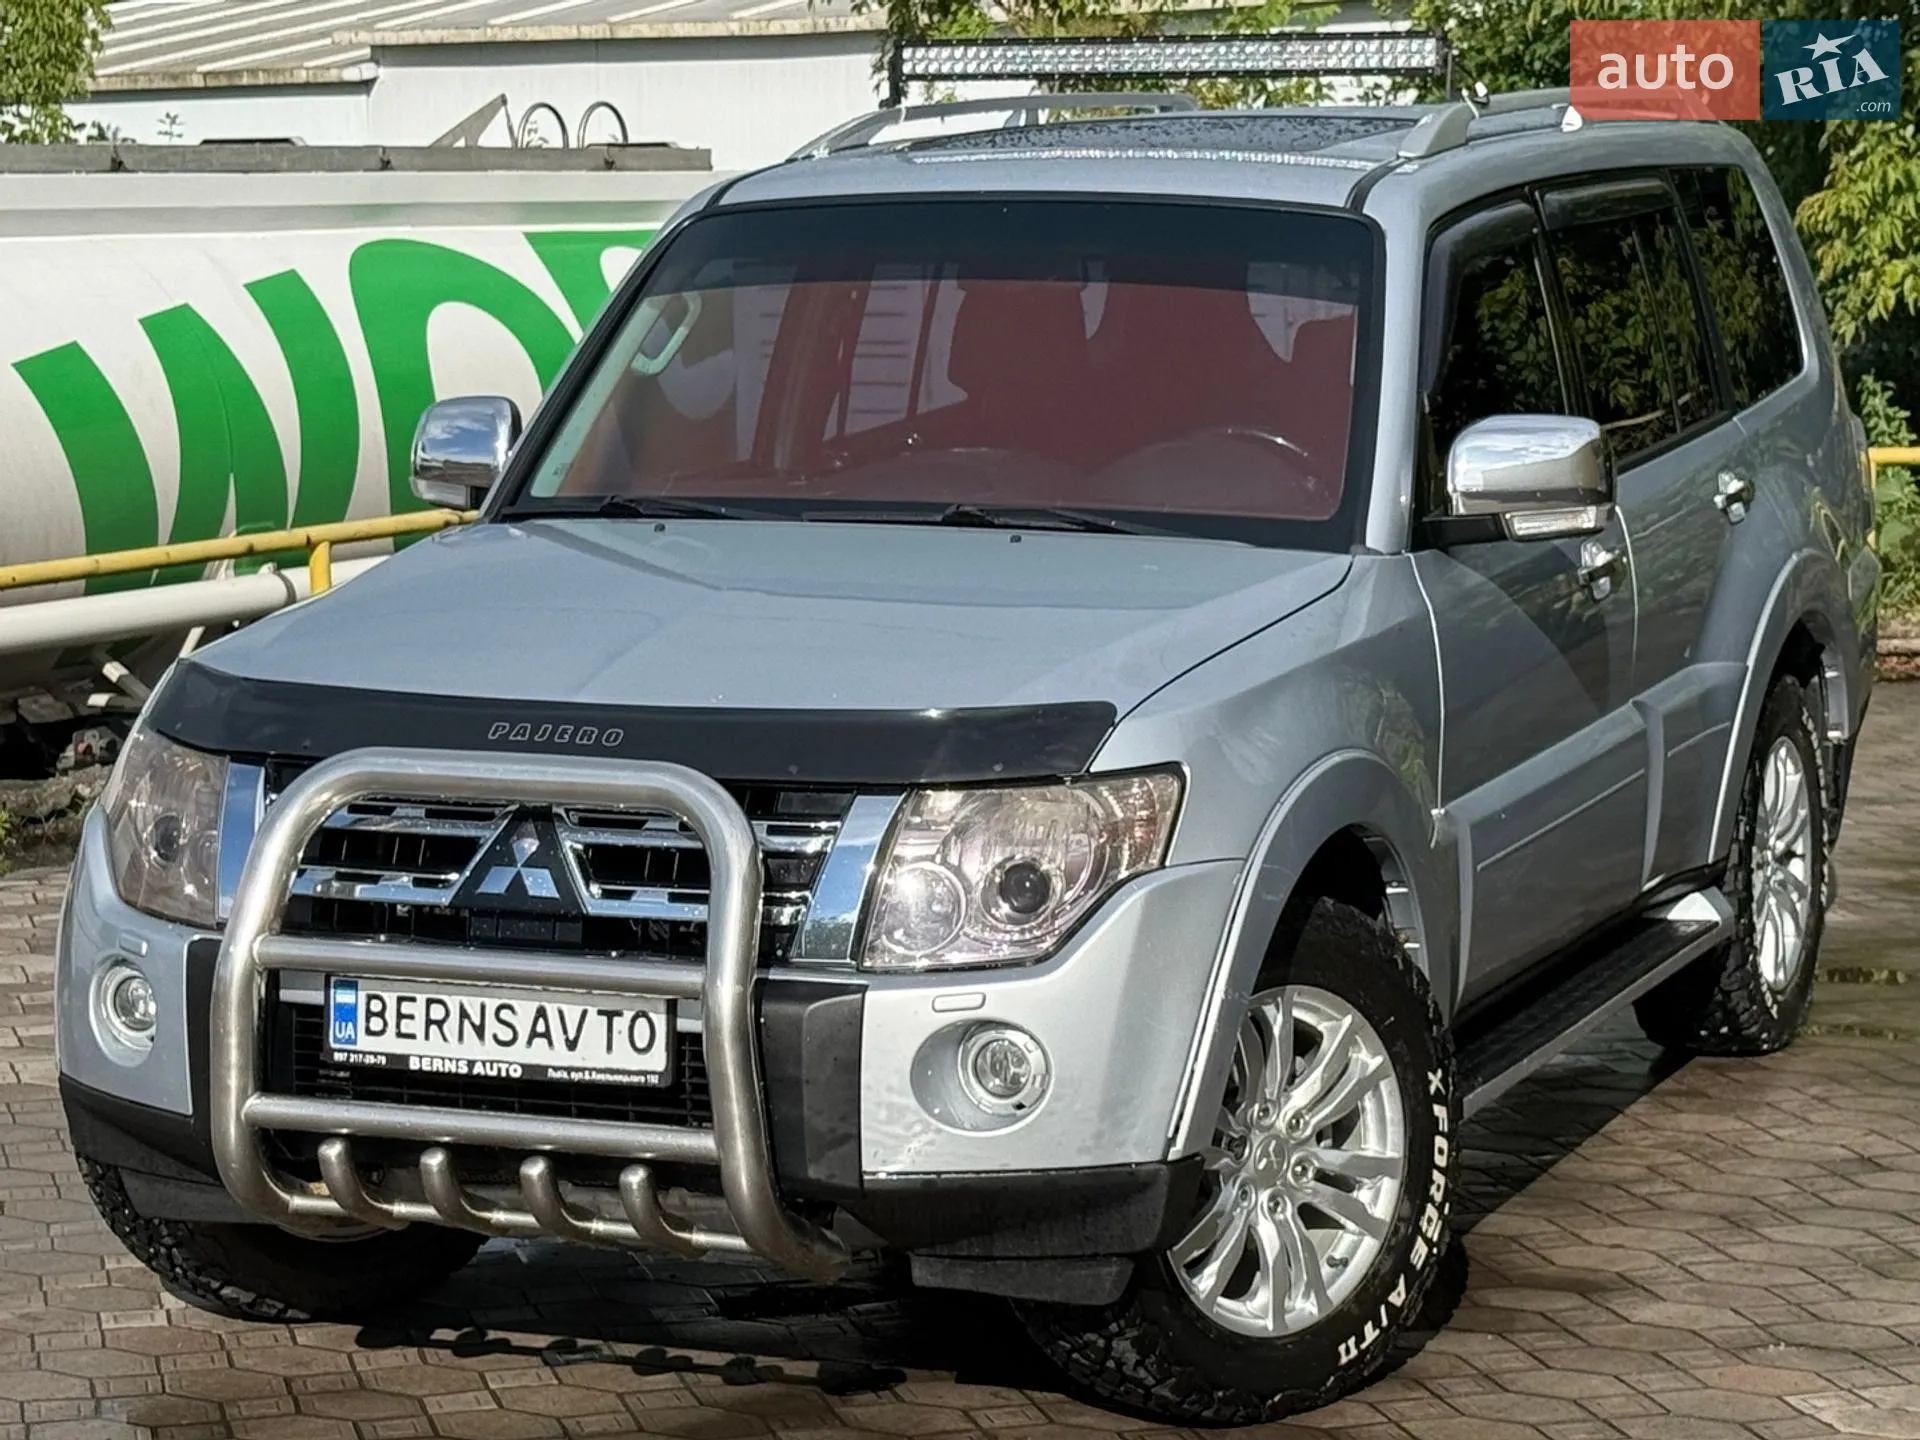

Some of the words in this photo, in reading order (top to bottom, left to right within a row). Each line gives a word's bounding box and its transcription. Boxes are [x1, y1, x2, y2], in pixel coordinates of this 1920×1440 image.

[488, 722, 624, 747] PAJERO
[335, 1021, 356, 1040] UA
[408, 1055, 469, 1075] BERNS
[472, 1061, 523, 1079] AUTO
[1427, 1068, 1445, 1095] X
[1410, 1103, 1449, 1270] FORCE
